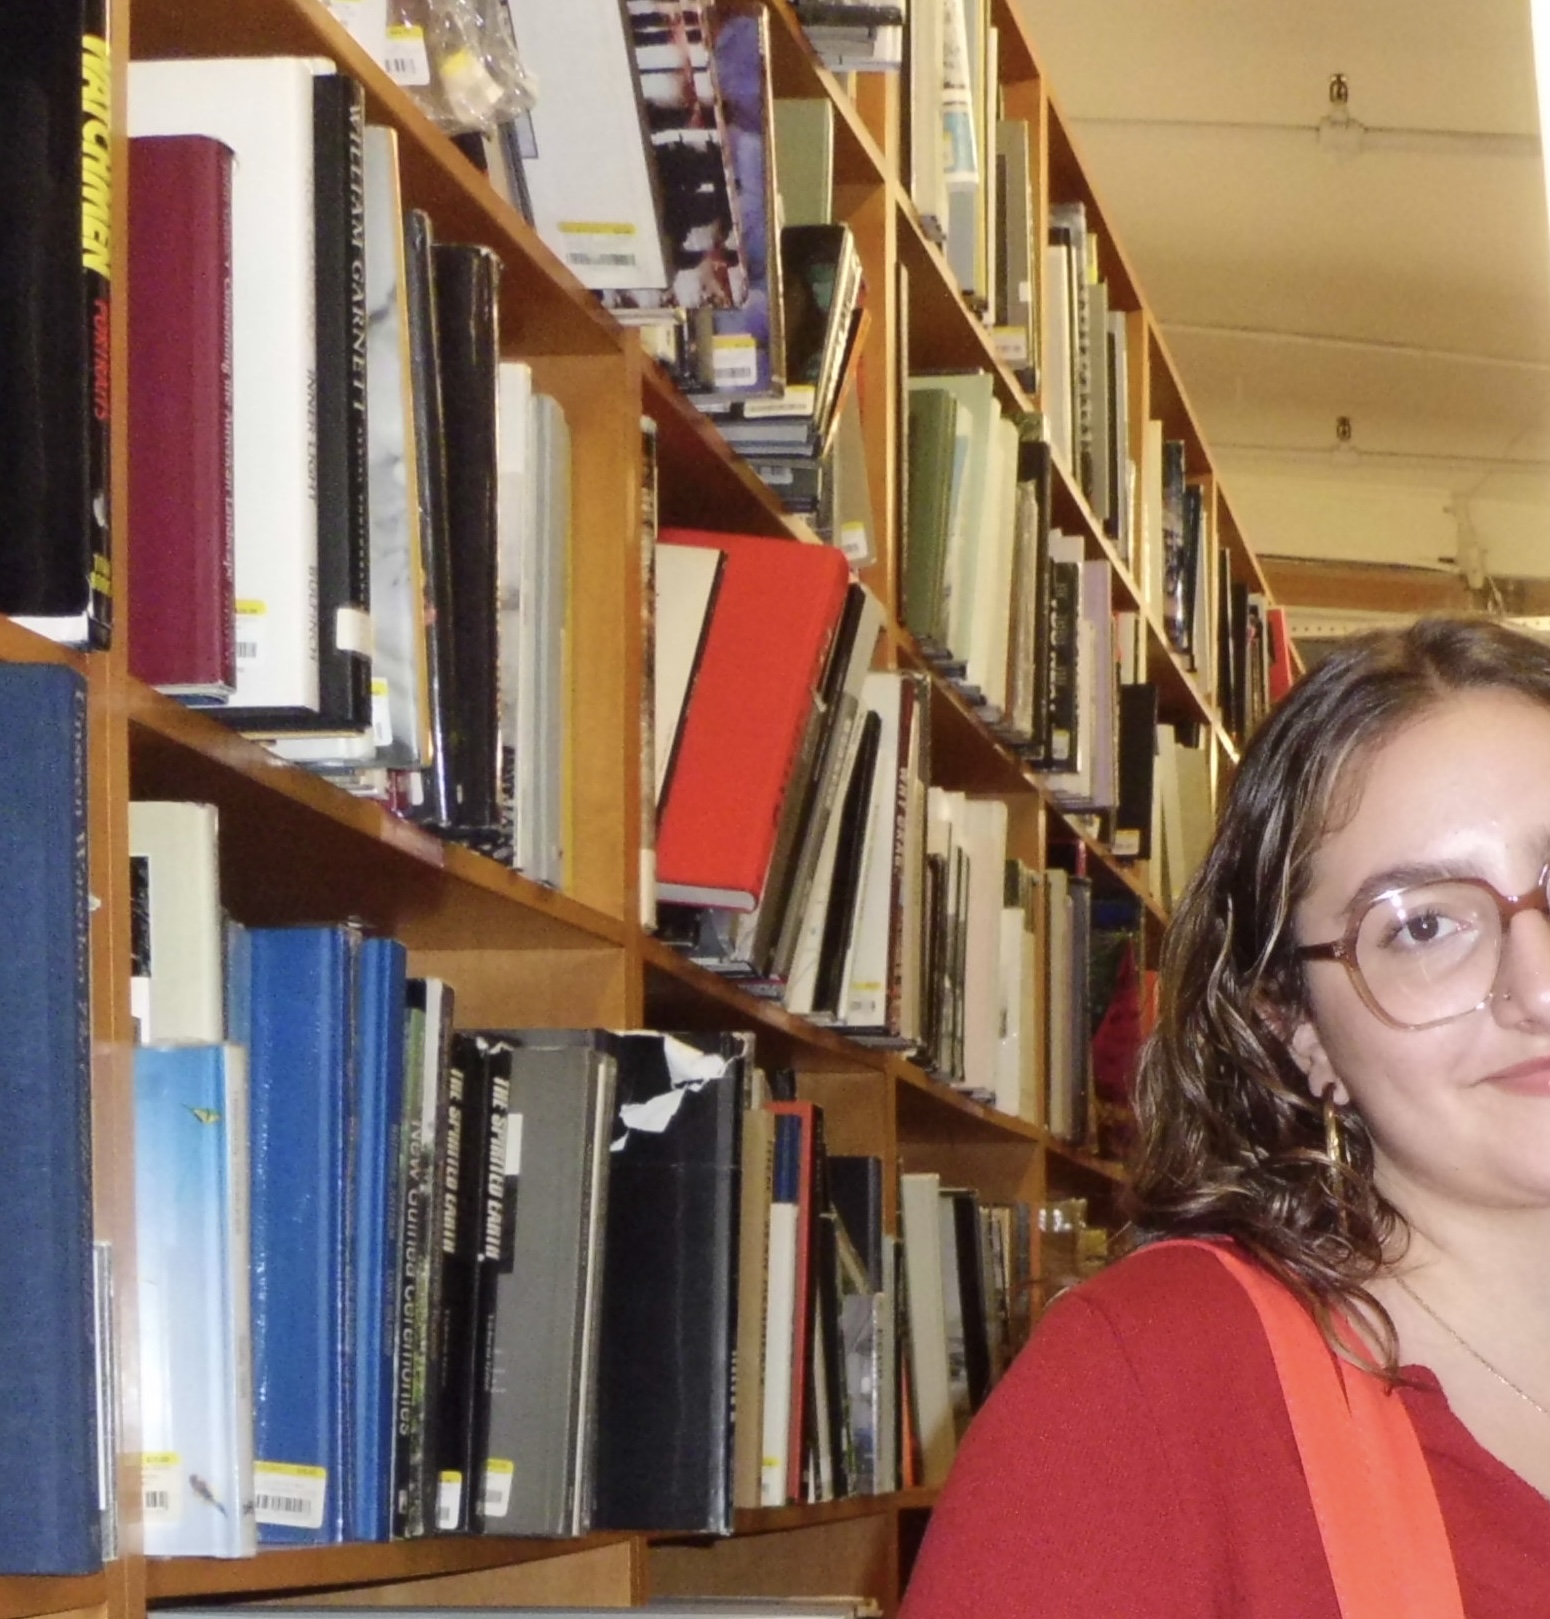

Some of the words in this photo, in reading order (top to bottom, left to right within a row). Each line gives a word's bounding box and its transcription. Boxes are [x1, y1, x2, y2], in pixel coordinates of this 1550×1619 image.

[82, 35, 111, 278] WATCHMEN
[348, 105, 364, 248] WILLIAM
[93, 298, 109, 421] PORTRAITS
[351, 260, 368, 414] GARNETT
[307, 370, 317, 438] INNER
[224, 411, 233, 490] American
[307, 442, 317, 504] LIGHT
[223, 497, 233, 580] Landscape
[451, 1068, 465, 1100] THE
[493, 1077, 509, 1108] THE
[408, 1119, 423, 1181] New
[445, 1106, 463, 1187] SPIRITED
[488, 1114, 509, 1195] SPIRITED
[404, 1188, 423, 1276] Guinea
[443, 1193, 459, 1254] EARTH
[485, 1200, 504, 1260] EARTH
[400, 1285, 416, 1434] Ceremonies
